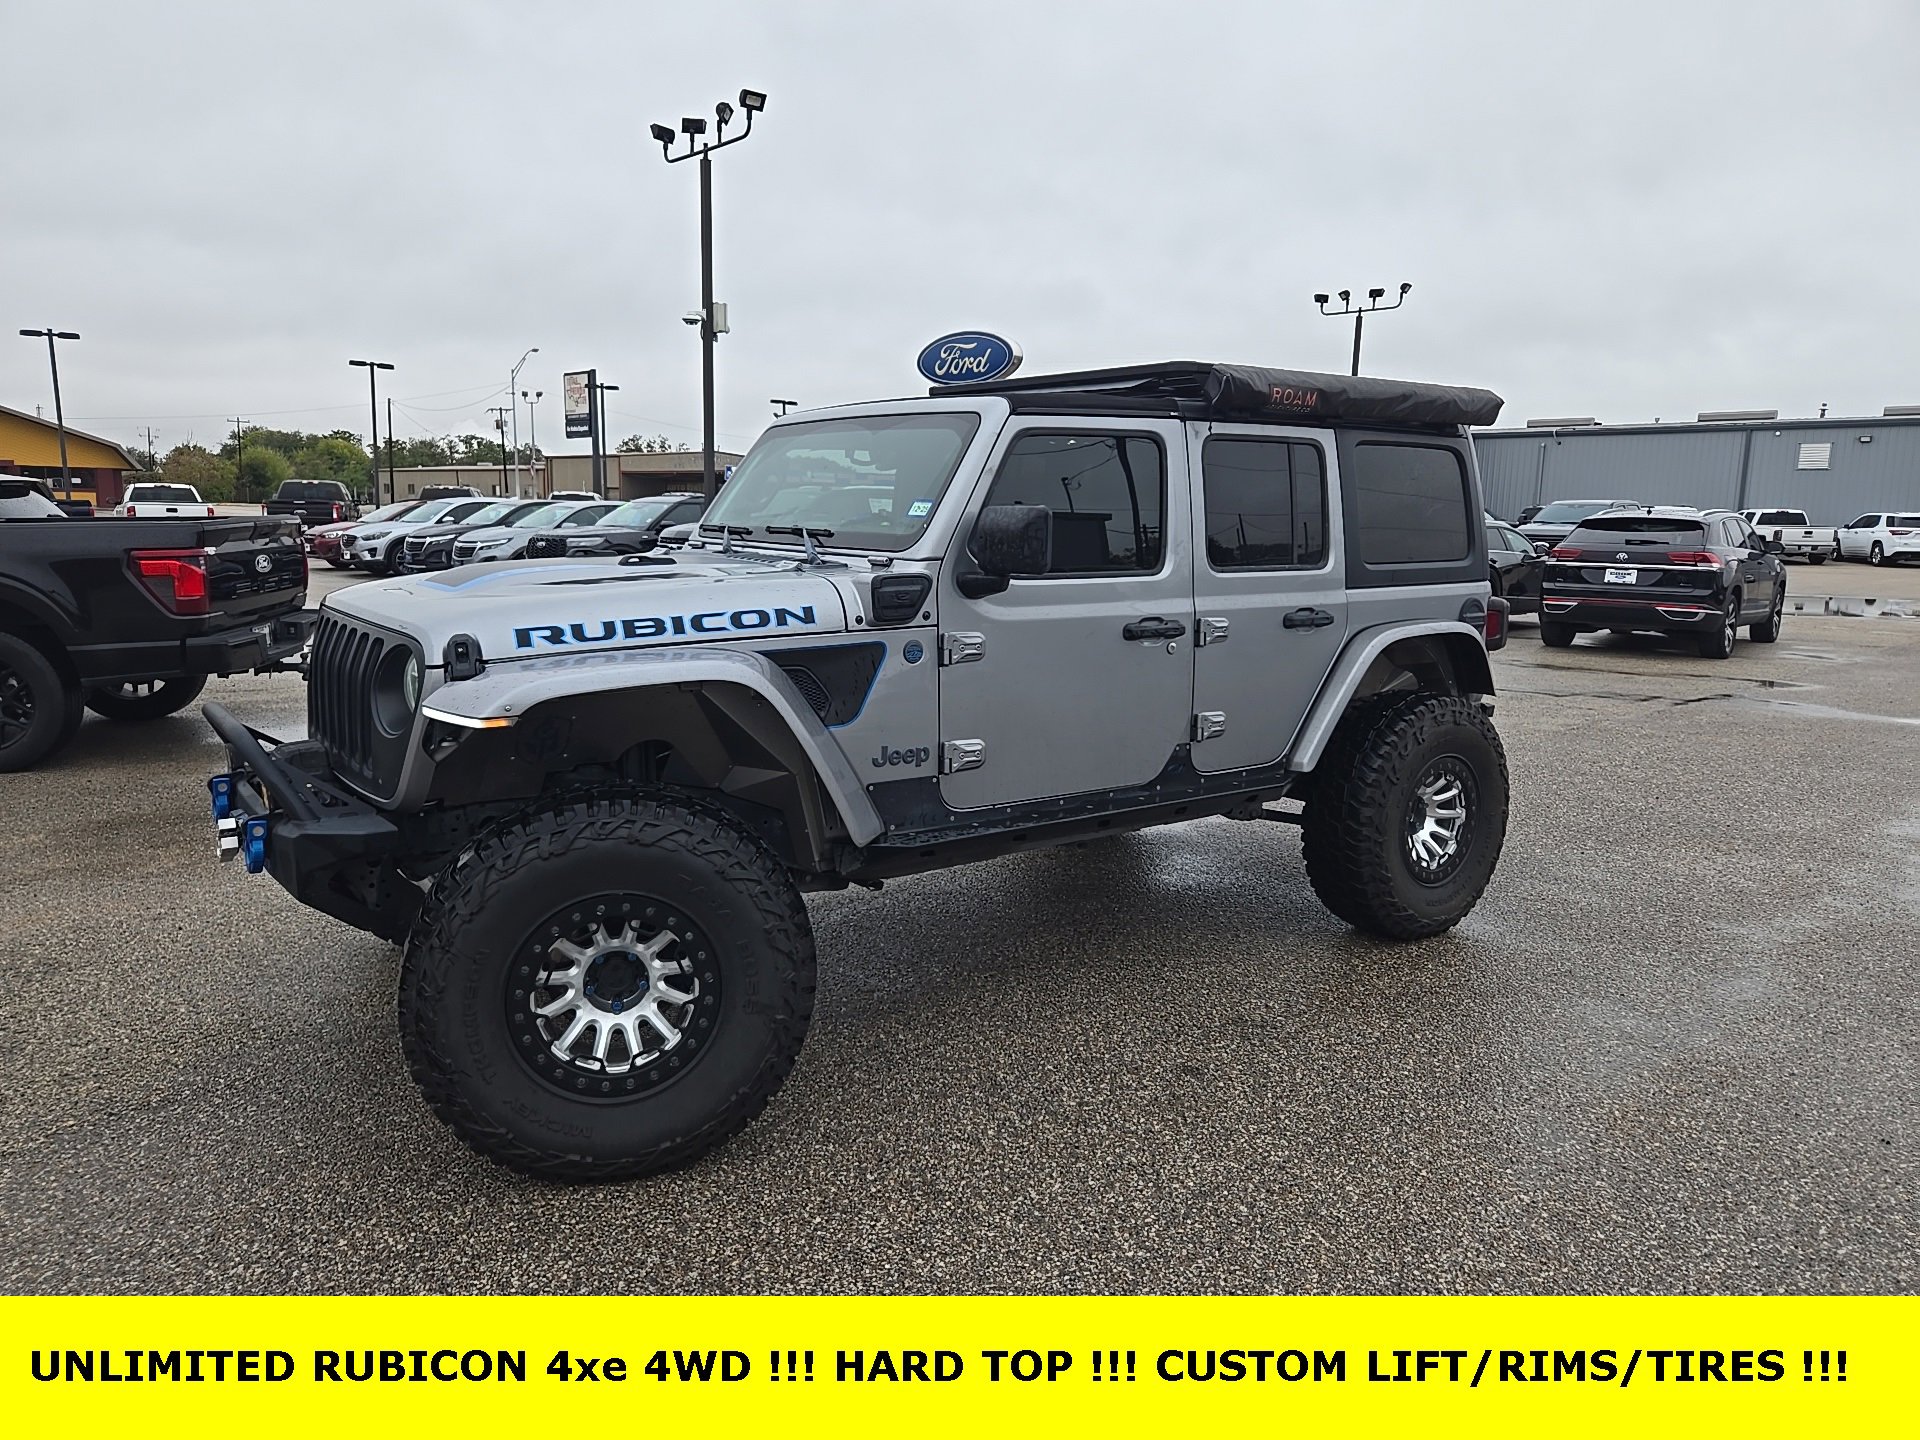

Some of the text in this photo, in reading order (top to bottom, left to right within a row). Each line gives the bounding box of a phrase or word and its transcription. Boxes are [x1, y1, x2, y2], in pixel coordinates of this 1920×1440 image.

[934, 342, 991, 376] Ford
[1271, 387, 1318, 407] ROAM
[513, 604, 818, 650] RUBICON
[871, 745, 931, 768] Jeep
